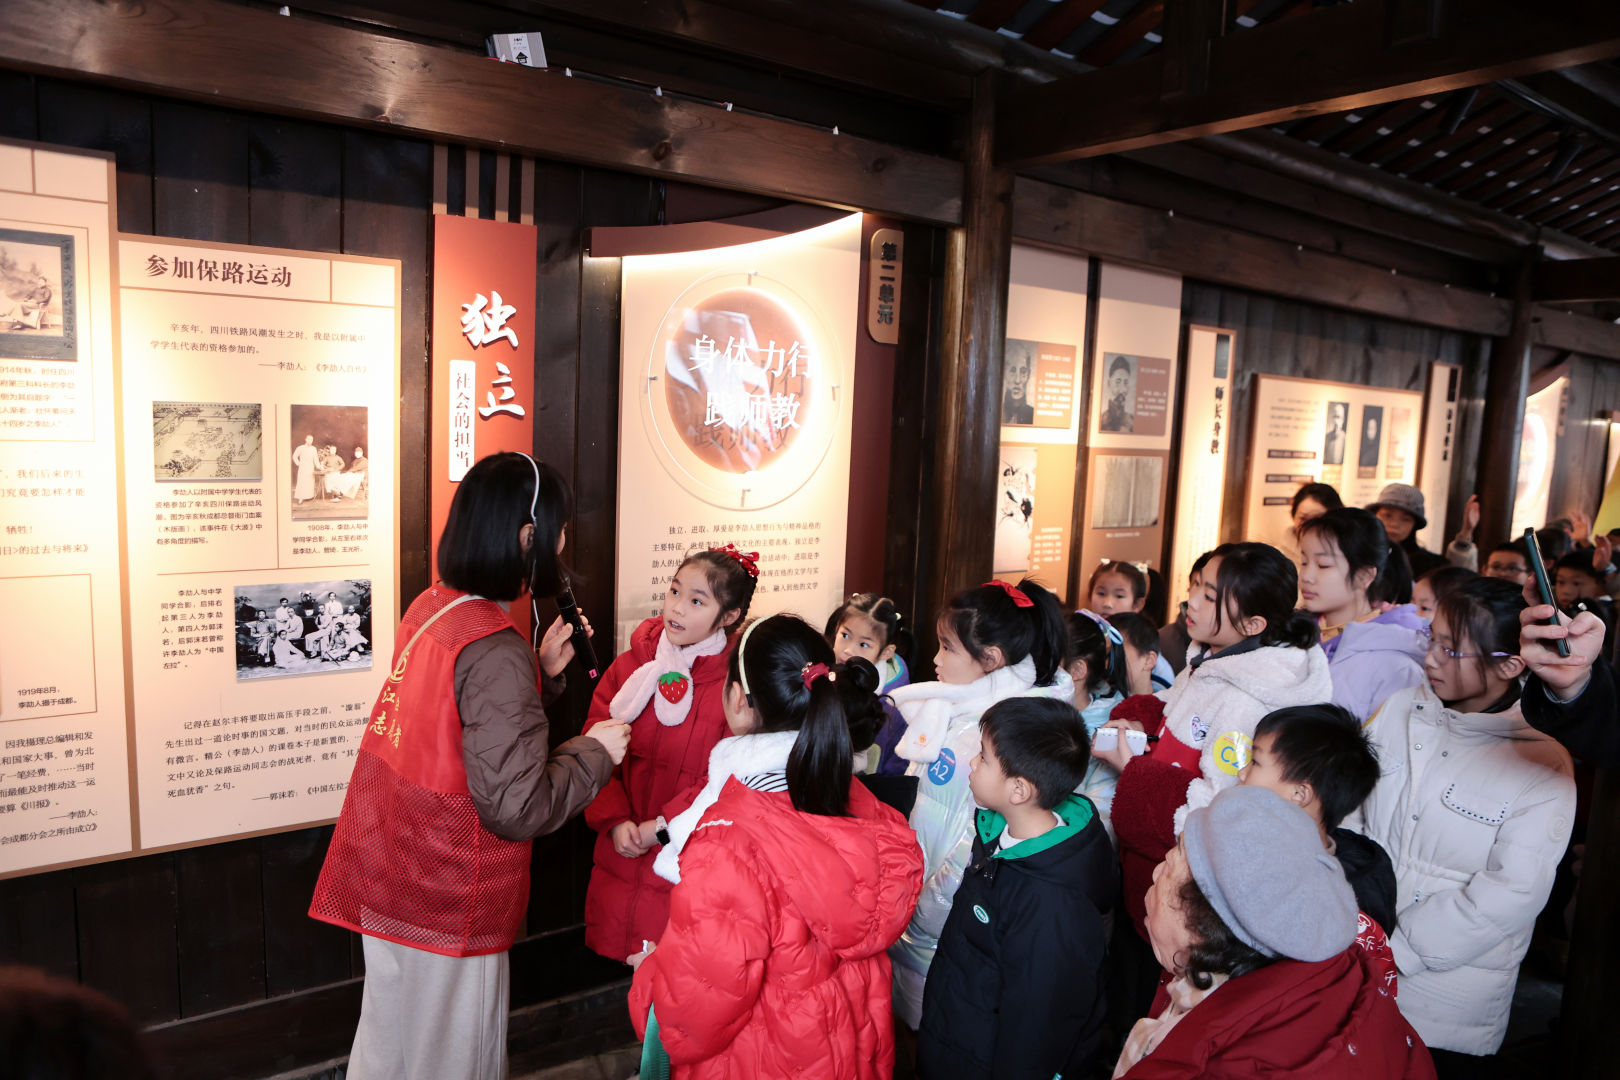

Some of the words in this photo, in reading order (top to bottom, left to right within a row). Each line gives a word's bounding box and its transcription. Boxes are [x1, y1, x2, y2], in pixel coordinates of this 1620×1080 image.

[144, 254, 292, 288] 参加保路运动
[877, 241, 897, 325] 第二单元
[460, 290, 525, 417] 独立
[688, 334, 813, 380] 身体力行
[0, 748, 94, 765] 和国家大事，曾为北
[930, 758, 950, 781] A2
